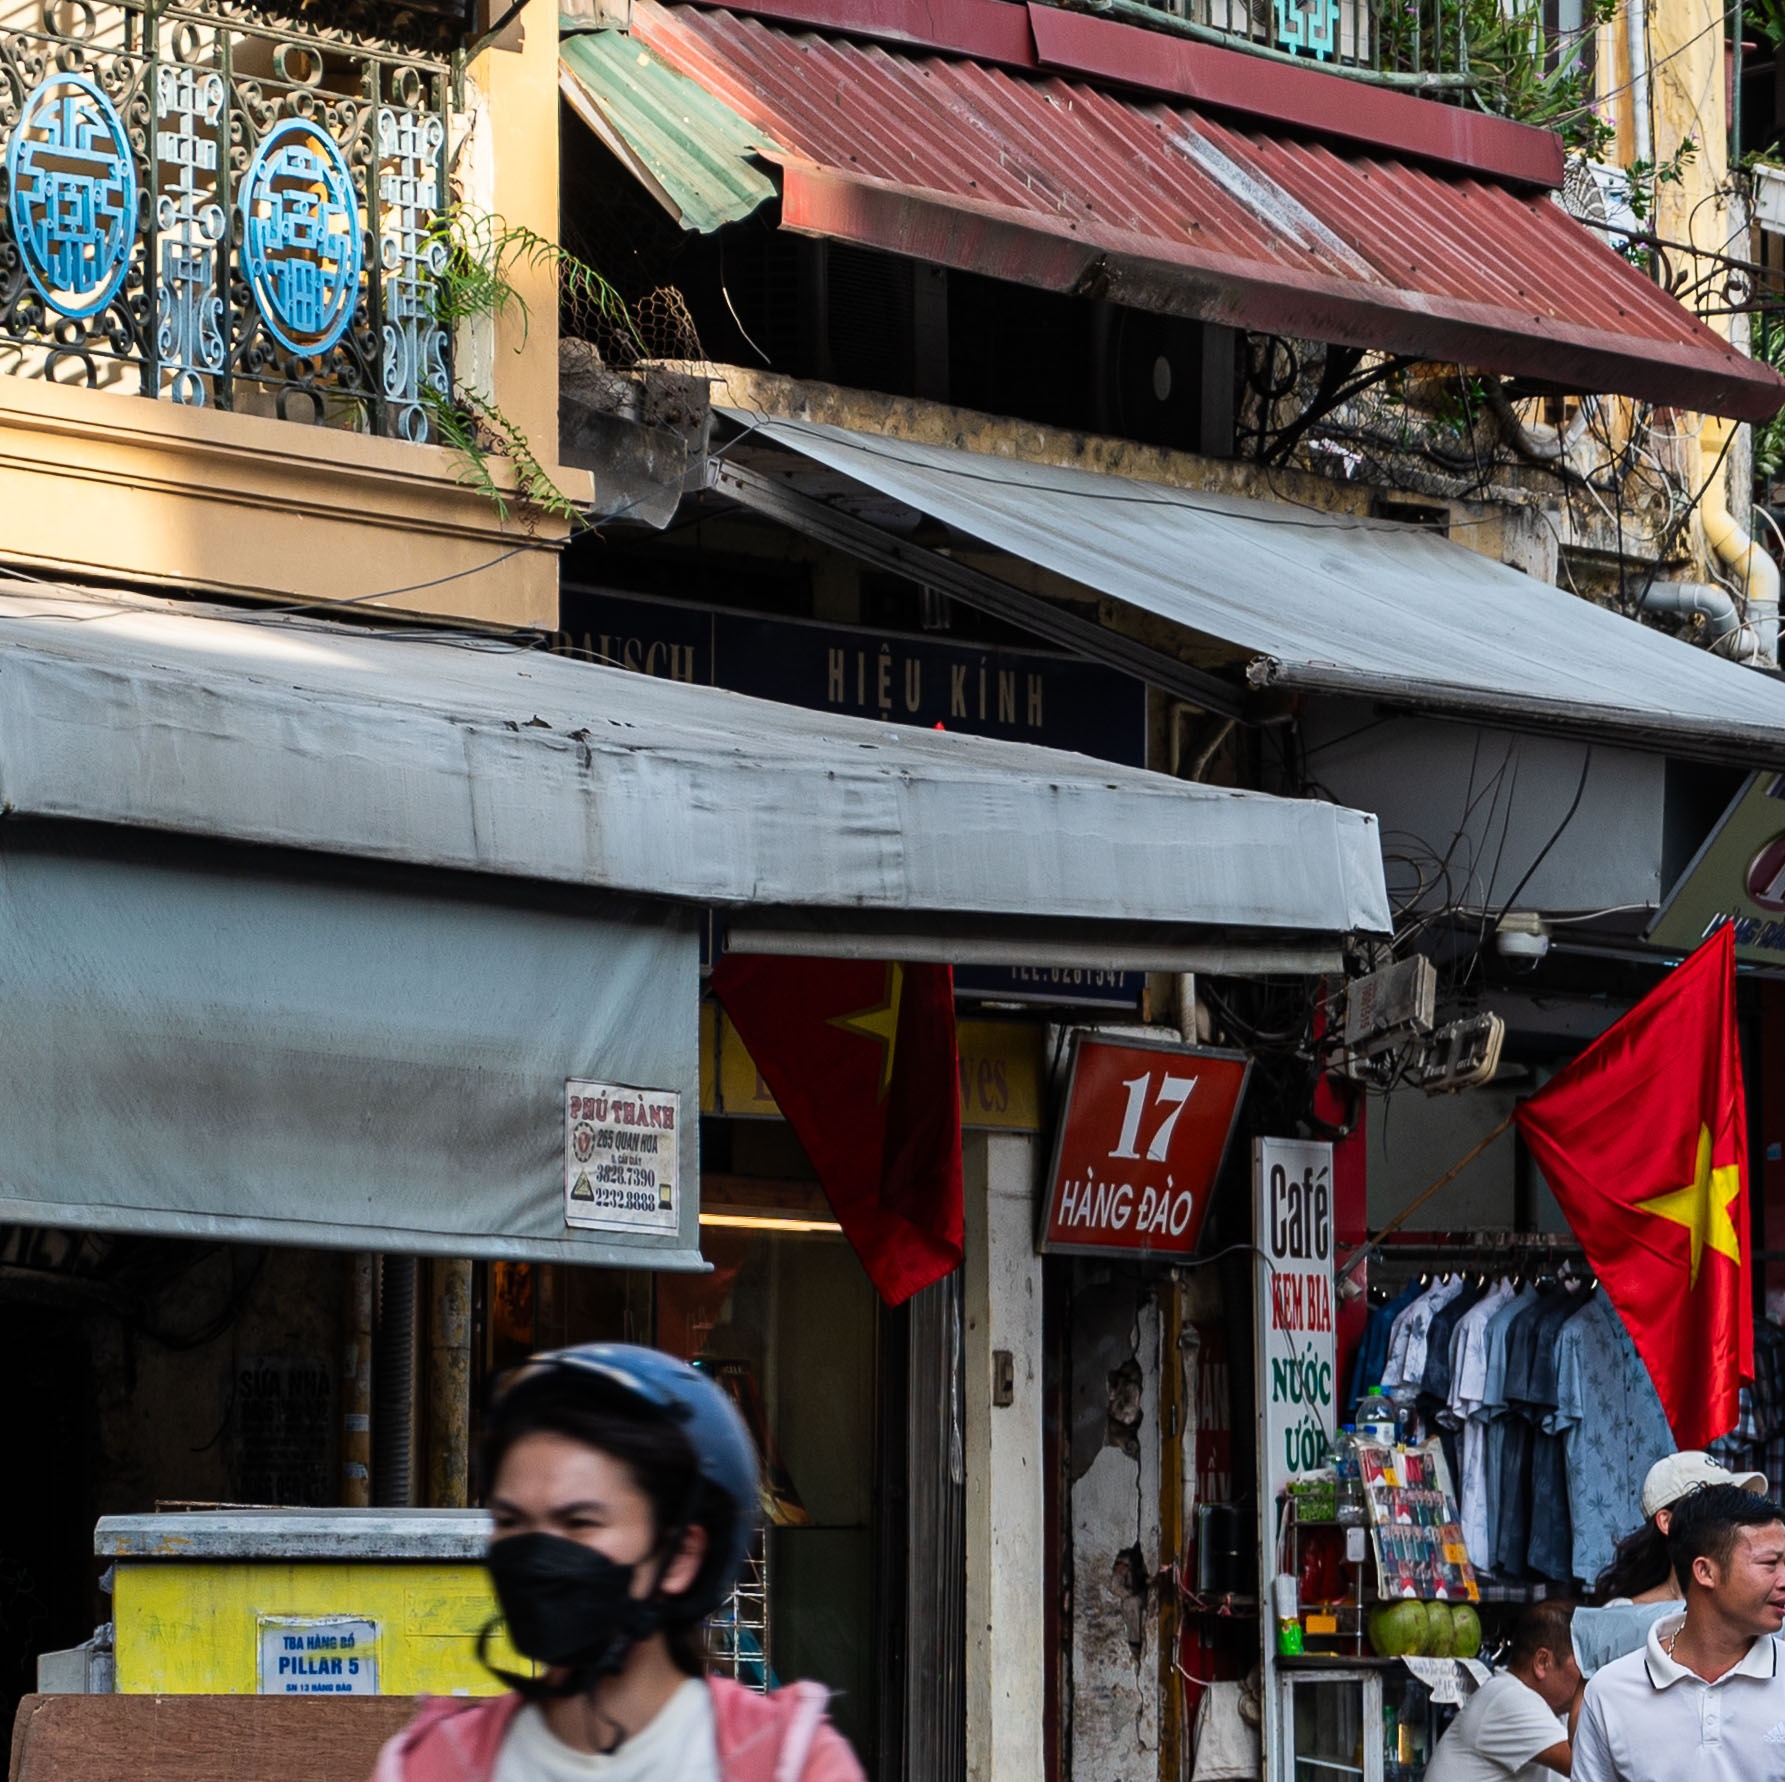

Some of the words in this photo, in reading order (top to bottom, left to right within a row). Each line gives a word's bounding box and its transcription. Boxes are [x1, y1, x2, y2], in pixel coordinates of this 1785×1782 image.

[828, 644, 921, 720] HIỆU
[951, 655, 1043, 728] KÍNH
[571, 1090, 608, 1122] PHÚ
[611, 1094, 675, 1130] THÀNH
[597, 1129, 613, 1149] 265
[615, 1131, 640, 1151] QUAN
[1108, 1071, 1198, 1162] 17
[1058, 1166, 1133, 1230] HÀNG
[1136, 1174, 1192, 1237] ĐÀO
[1270, 1163, 1329, 1260] Café
[1272, 1272, 1303, 1332] KEM
[1307, 1274, 1331, 1333] BIA
[1272, 1341, 1331, 1405] NƯỚC
[279, 1656, 342, 1675] PILLAR
[348, 1657, 359, 1675] 5
[283, 1636, 304, 1650] TBA
[307, 1634, 338, 1650] HÀNG
[286, 1684, 298, 1692] SN
[300, 1684, 309, 1692] 13
[311, 1683, 334, 1692] HÀNG
